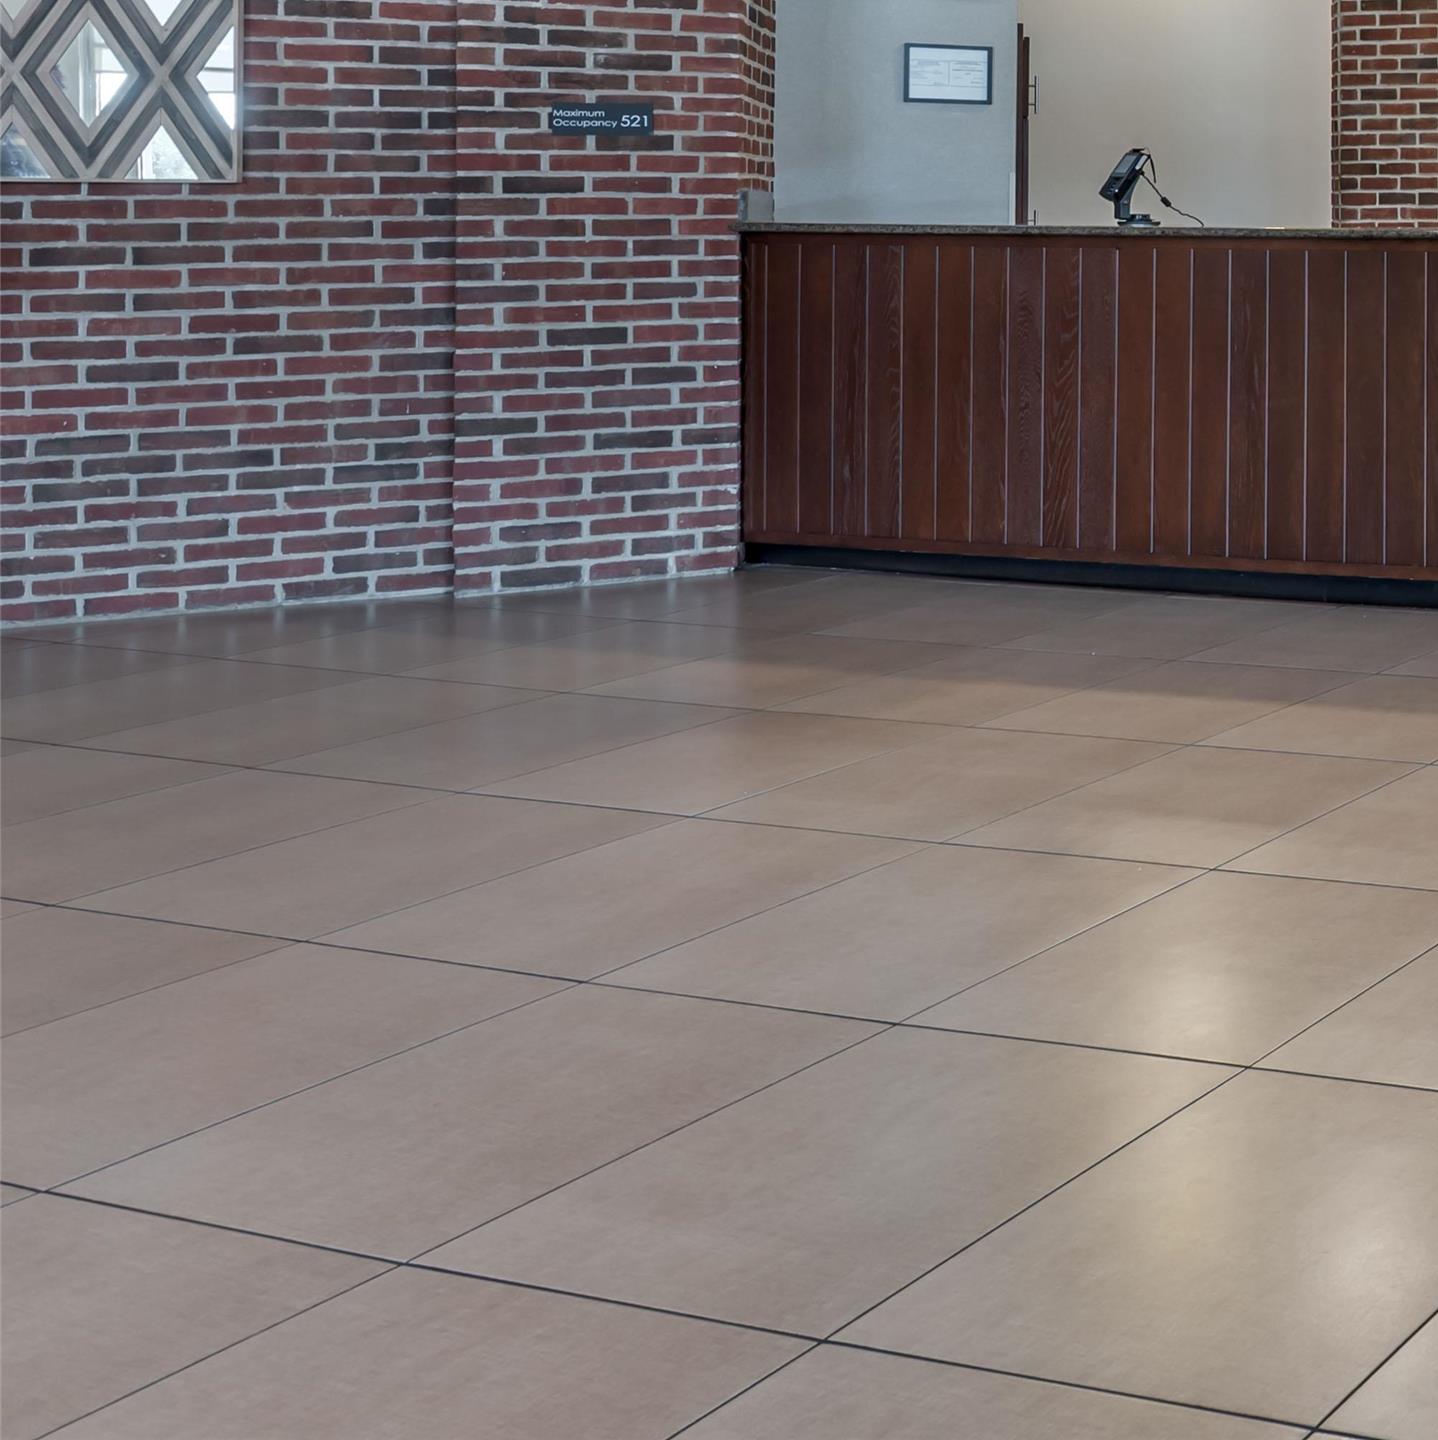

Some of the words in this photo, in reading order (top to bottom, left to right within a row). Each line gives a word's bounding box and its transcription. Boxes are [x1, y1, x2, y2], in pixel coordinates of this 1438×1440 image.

[553, 109, 605, 118] Maximum
[553, 118, 617, 128] Occupancy
[620, 115, 648, 128] 521
